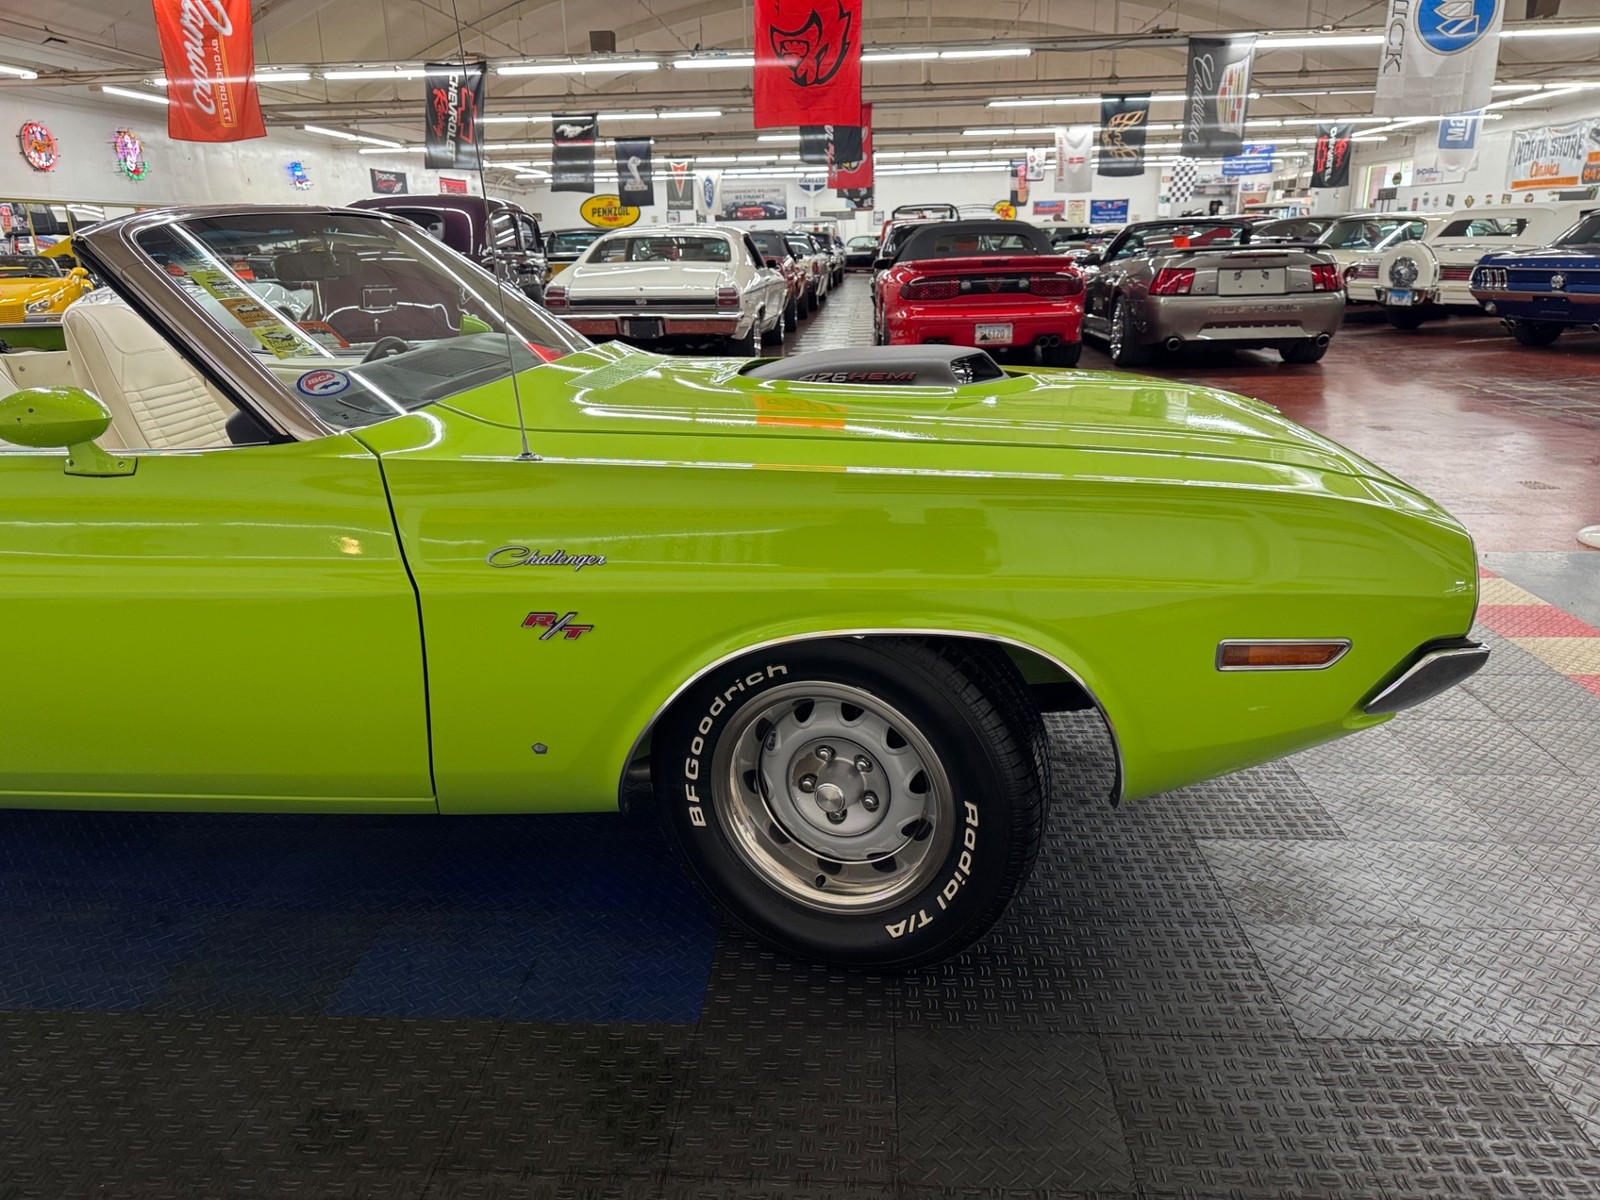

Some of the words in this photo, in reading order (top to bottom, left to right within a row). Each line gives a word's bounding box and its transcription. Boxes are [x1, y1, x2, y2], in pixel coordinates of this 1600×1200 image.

[211, 39, 220, 53] BY
[1383, 0, 1408, 74] ICK
[213, 54, 232, 121] CHEVROLET
[1188, 53, 1214, 143] Cadillac
[446, 73, 459, 161] CHEVROLET
[1514, 139, 1548, 167] NORTH
[1549, 134, 1585, 160] SHORE
[592, 206, 630, 217] PENNZOIL
[1207, 303, 1303, 315] MUSTANG
[307, 373, 334, 385] ISCA
[799, 372, 848, 382] 426
[849, 371, 917, 381] HEMI
[486, 545, 606, 572] Challenger
[521, 612, 594, 640] R/T
[685, 663, 788, 827] BFGoodrich
[937, 800, 979, 910] Radial
[885, 909, 933, 939] T/A
